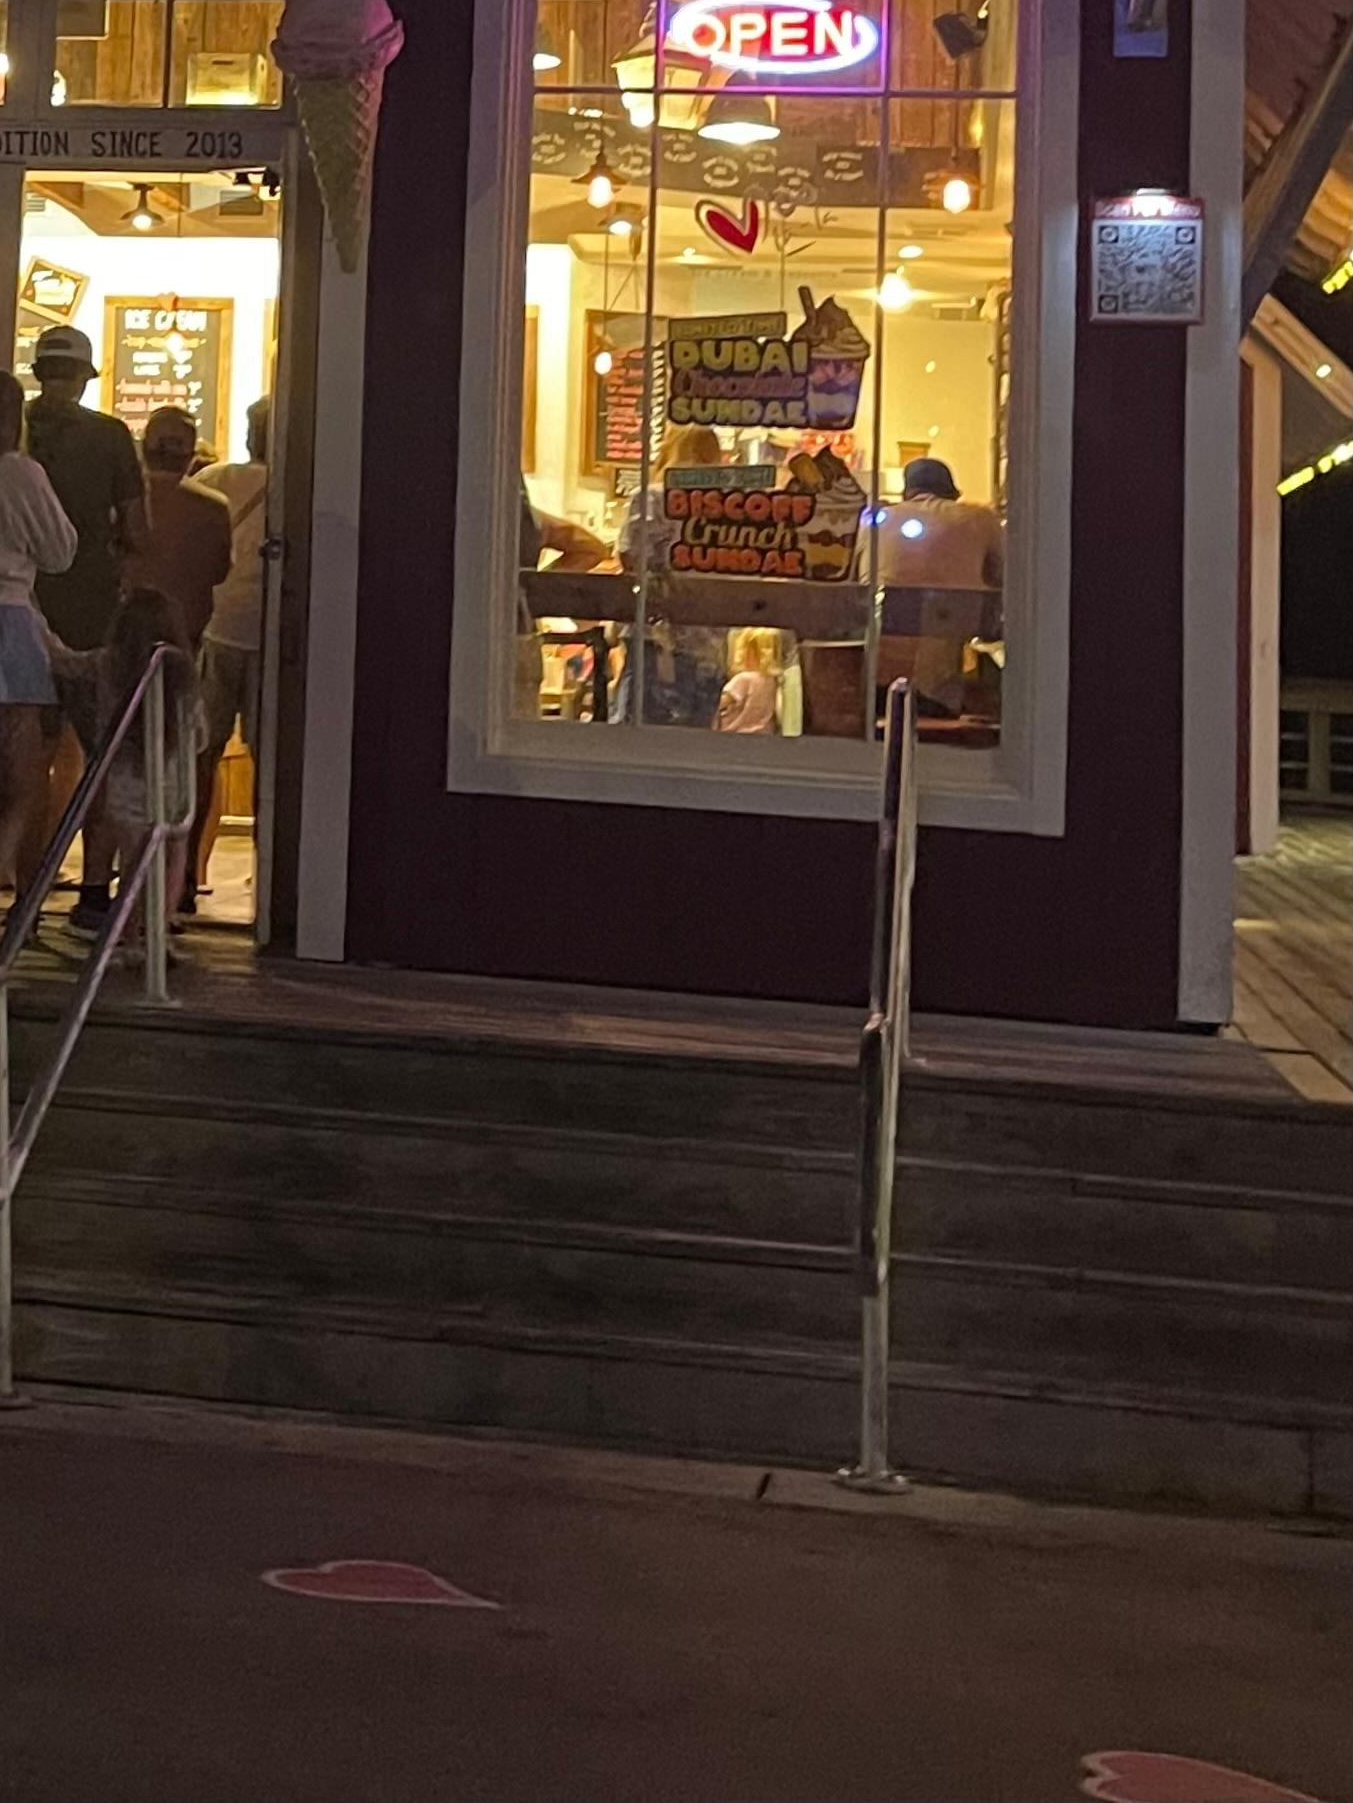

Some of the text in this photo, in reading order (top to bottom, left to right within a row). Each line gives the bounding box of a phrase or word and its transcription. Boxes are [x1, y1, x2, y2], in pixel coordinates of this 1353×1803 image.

[690, 9, 857, 58] OPEN
[91, 131, 162, 157] SINCE
[185, 132, 244, 158] 2013
[672, 341, 808, 373] DUBAI
[671, 397, 806, 424] SUNDAE
[667, 490, 812, 522] BISCOFF
[684, 516, 794, 550] Crunch
[672, 546, 803, 575] SUNDAE
